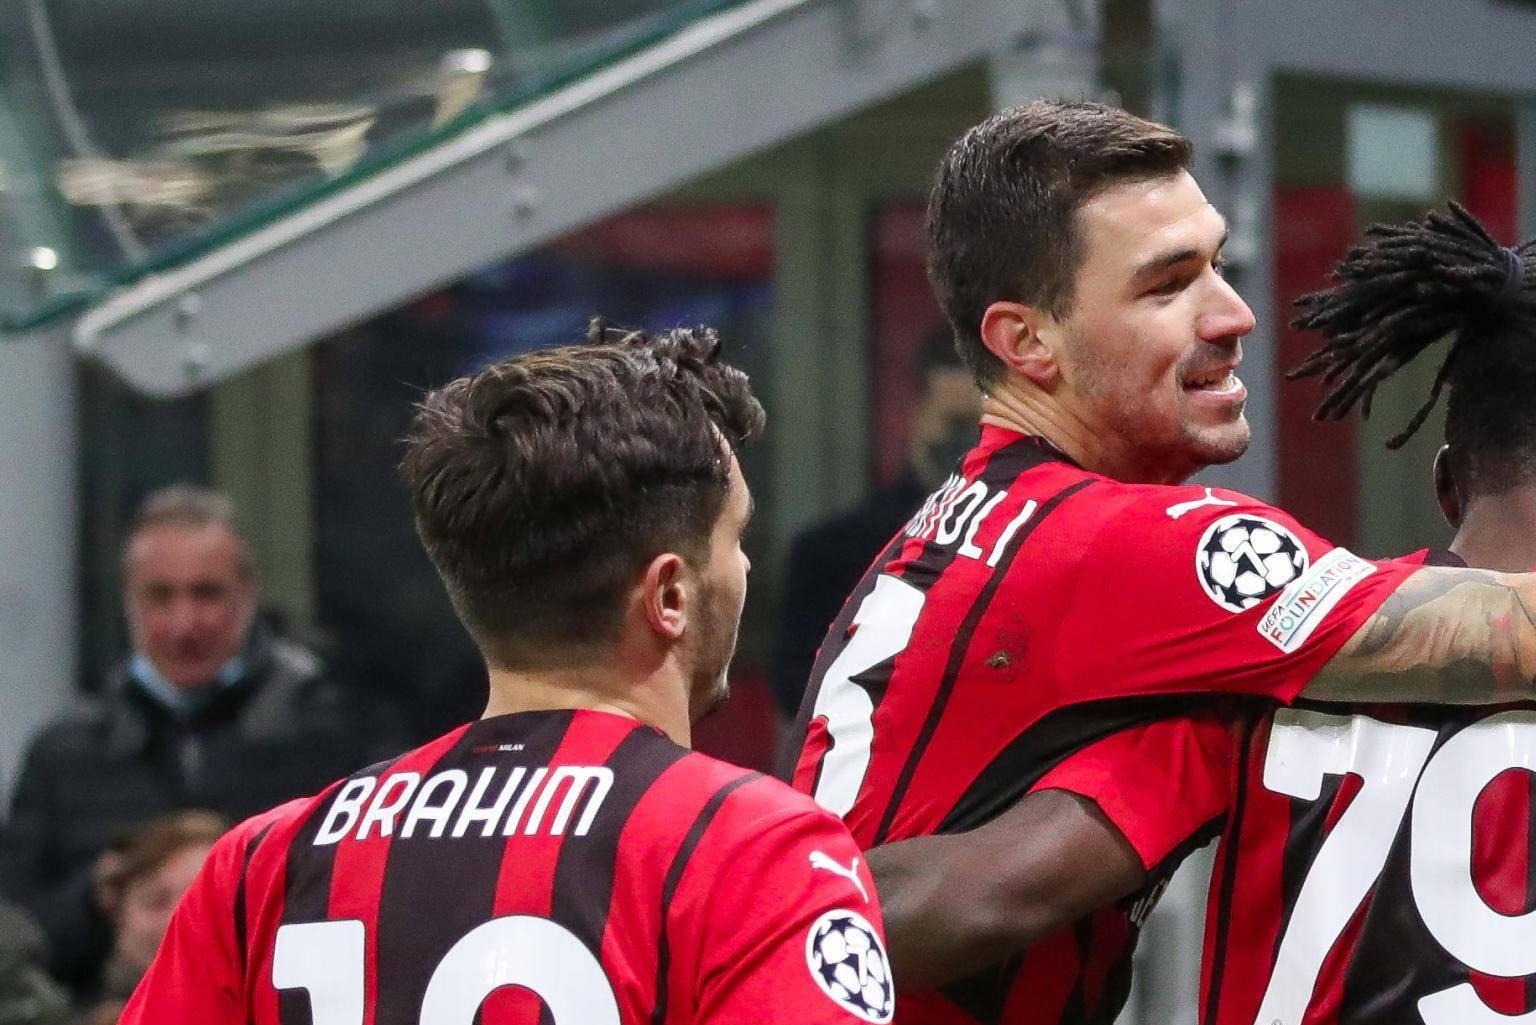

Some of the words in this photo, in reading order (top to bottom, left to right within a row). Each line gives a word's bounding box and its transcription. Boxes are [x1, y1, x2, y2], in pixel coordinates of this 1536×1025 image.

[1262, 606, 1285, 633] UEFA
[1271, 557, 1361, 643] FOUNDATION
[312, 765, 614, 846] BRAHIM
